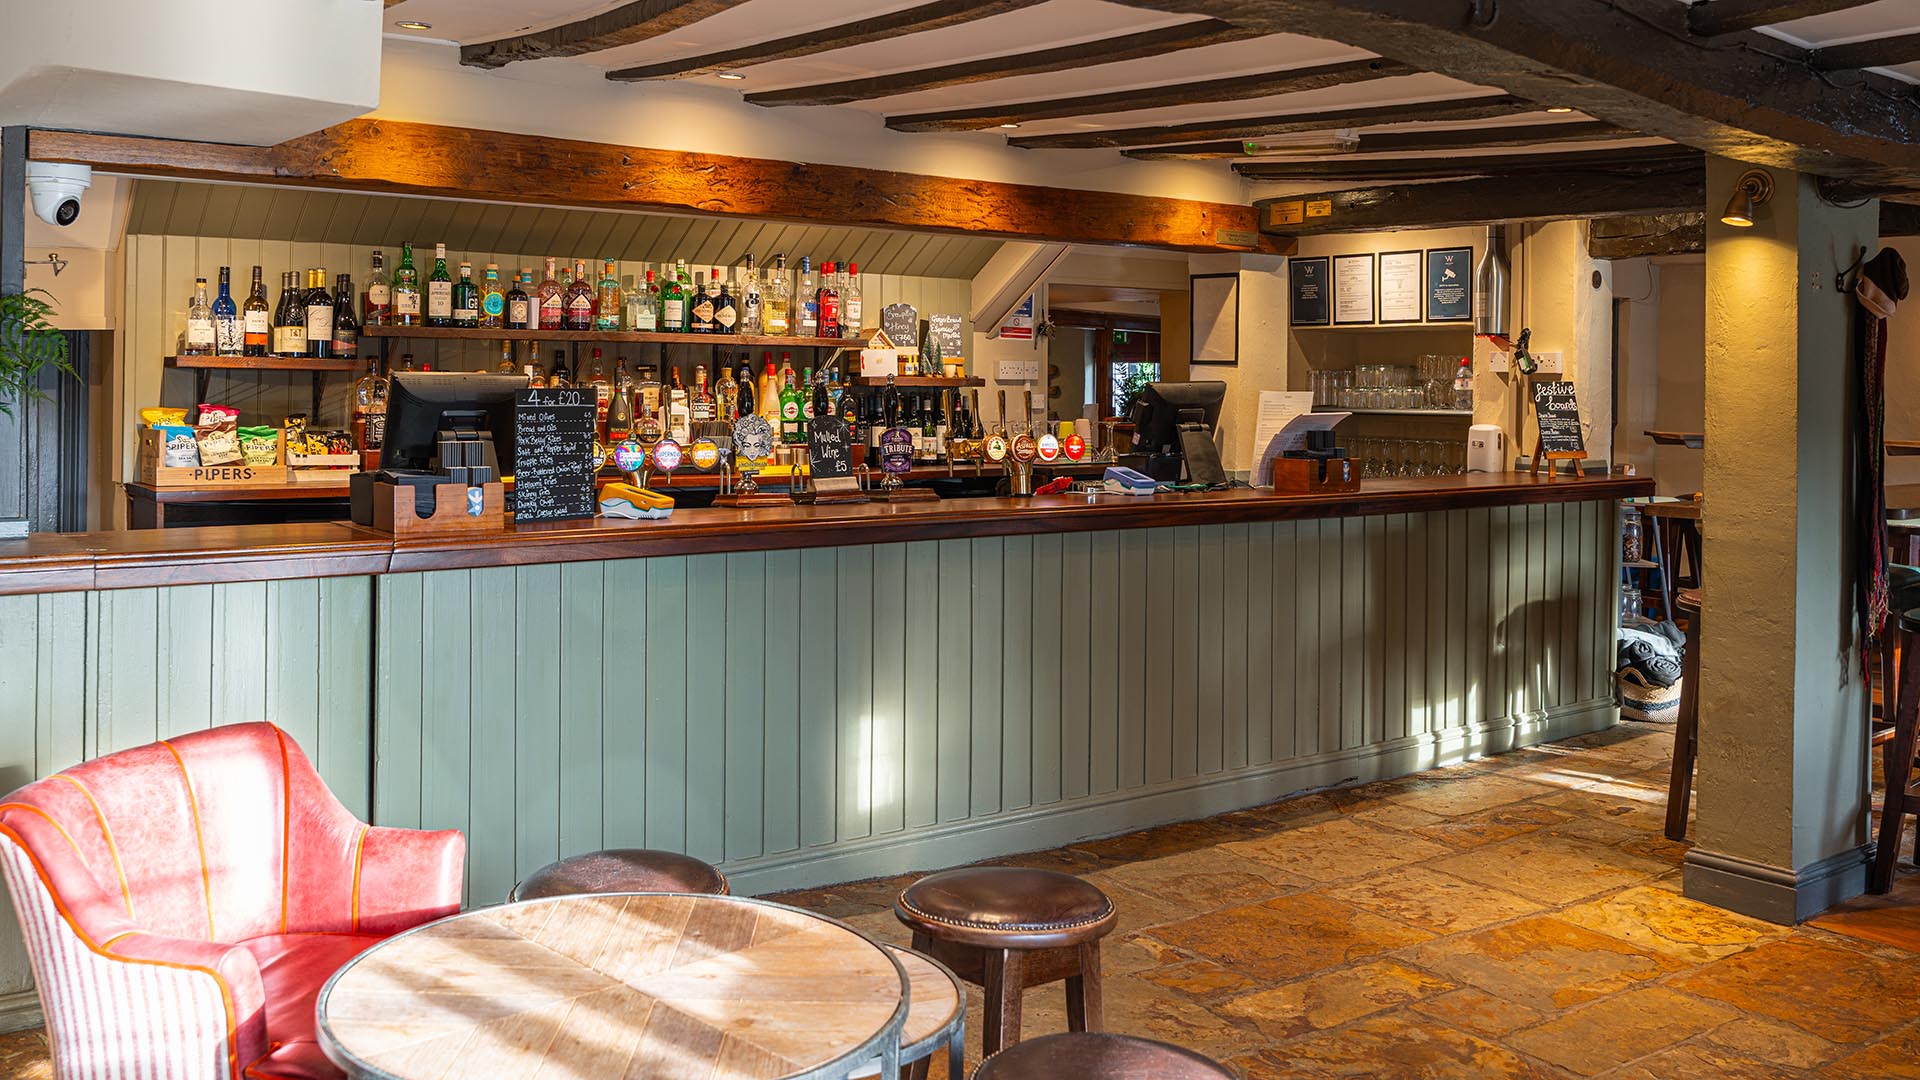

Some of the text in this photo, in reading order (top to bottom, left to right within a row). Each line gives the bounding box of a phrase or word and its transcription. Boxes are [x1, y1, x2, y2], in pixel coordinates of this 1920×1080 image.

[527, 389, 580, 407] 4 for £20
[1535, 382, 1576, 402] festive
[1545, 396, 1578, 411] boards
[518, 412, 536, 421] Mixed
[538, 412, 556, 421] Olives
[517, 423, 536, 433] Bread
[516, 435, 530, 445] Pork
[813, 428, 842, 444] Mulled
[245, 443, 277, 452] PIPERS
[563, 442, 577, 454] Squid
[820, 445, 840, 460] Wine
[883, 444, 915, 456] TRIBUTE
[555, 464, 571, 474] Onion
[834, 460, 848, 472] £5
[194, 468, 253, 481] PIPERS
[517, 489, 538, 502] Skinny
